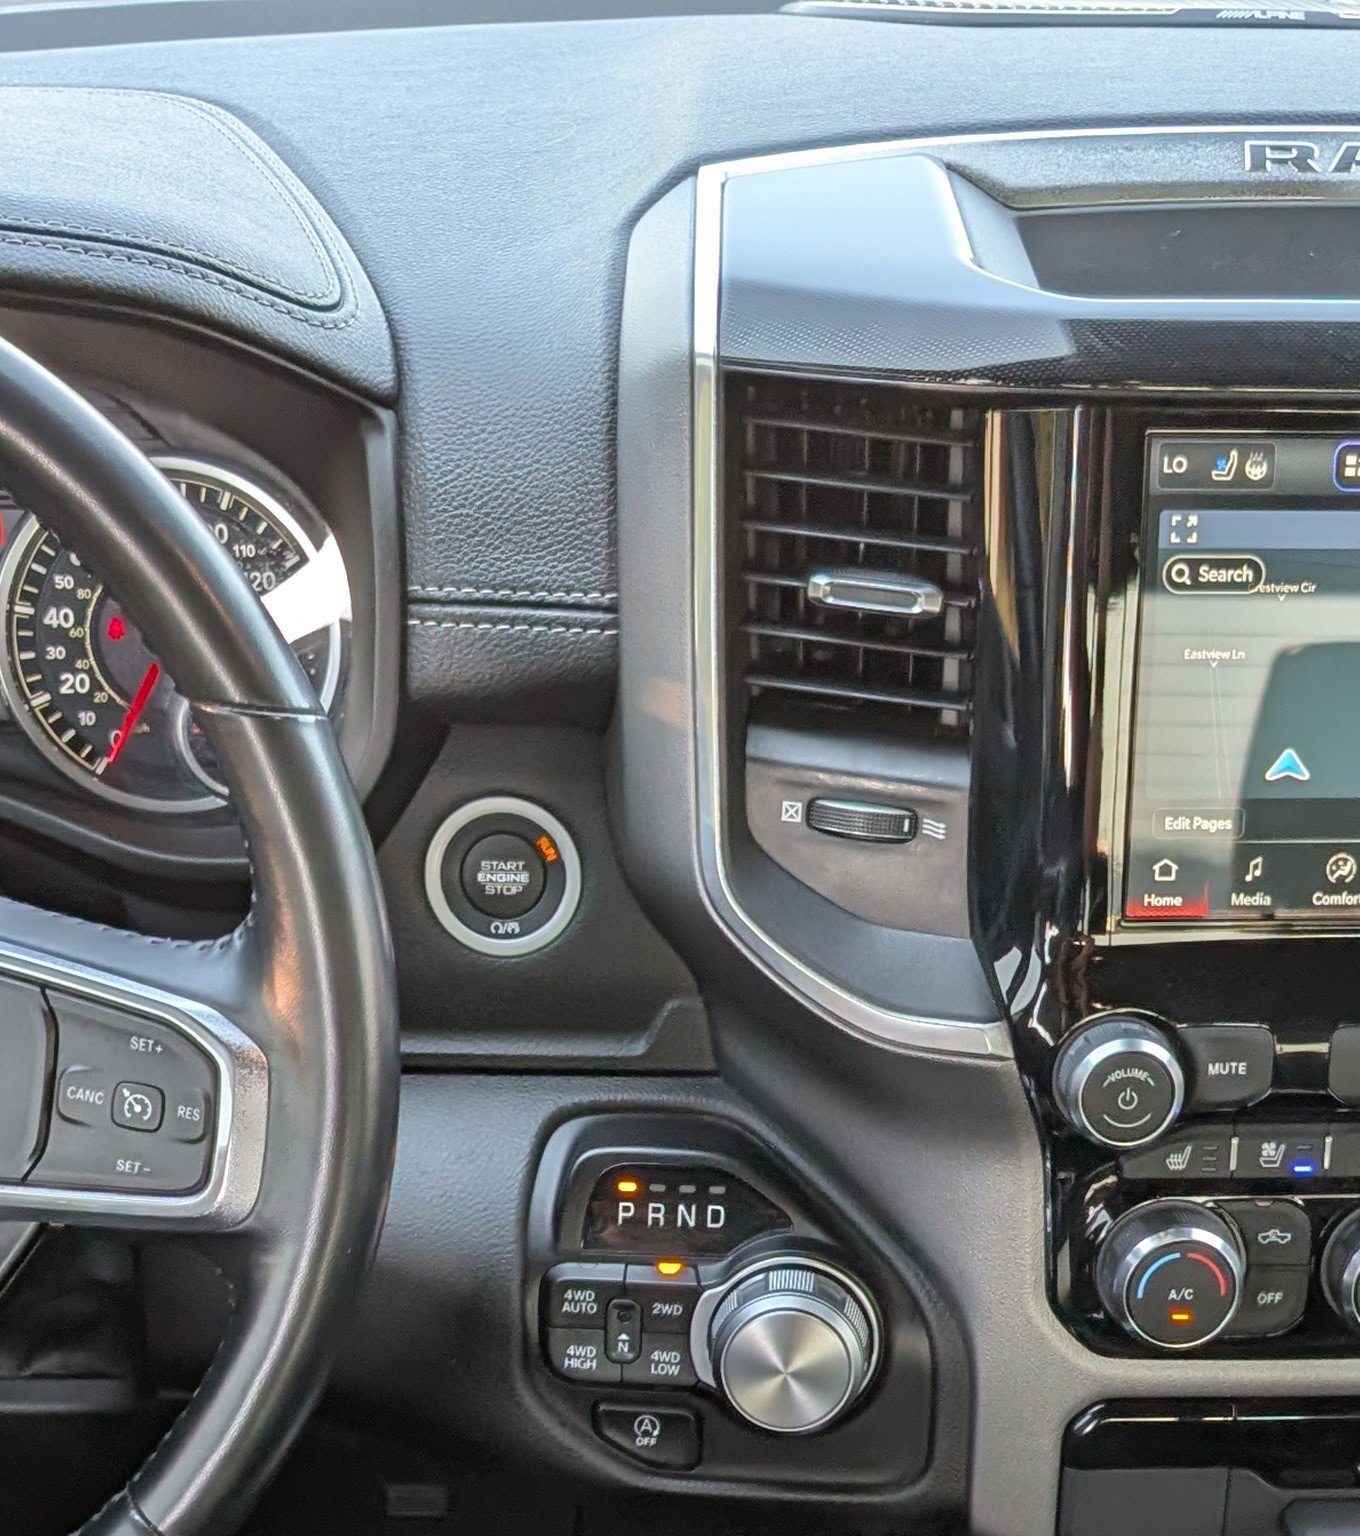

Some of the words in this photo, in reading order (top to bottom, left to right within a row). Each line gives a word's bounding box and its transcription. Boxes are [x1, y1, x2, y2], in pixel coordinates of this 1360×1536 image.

[1163, 454, 1188, 474] LO
[233, 544, 256, 558] 110
[1198, 565, 1254, 583] Search
[53, 574, 75, 591] 50
[244, 571, 276, 593] 20
[1300, 582, 1317, 594] Cir
[76, 586, 92, 600] 80
[43, 606, 75, 629] 40
[69, 626, 84, 639] 60
[45, 645, 67, 660] 30
[1184, 648, 1230, 661] Eastview
[1232, 648, 1245, 660] Ln
[74, 659, 90, 670] 40
[59, 672, 91, 695] 20
[93, 691, 109, 703] 20
[77, 711, 97, 726] 10
[1165, 817, 1190, 831] Edit
[1192, 817, 1233, 833] Pages
[480, 861, 526, 872] START
[477, 872, 530, 883] ENGINE
[484, 884, 524, 896] STOP
[1143, 893, 1183, 907] Home
[1230, 892, 1272, 906] Media
[1109, 1067, 1149, 1083] VOLUME
[1207, 1062, 1247, 1076] MUTE
[66, 1086, 105, 1106] CANC
[176, 1105, 200, 1122] RES
[618, 1201, 635, 1227] P
[647, 1202, 666, 1227] R
[676, 1203, 696, 1228] N
[706, 1204, 725, 1229] D
[564, 1289, 595, 1301] 4WD
[1168, 1287, 1194, 1301] A/C
[1257, 1292, 1284, 1305] OFF
[561, 1301, 597, 1315] AUTO
[652, 1302, 683, 1316] 2WD
[566, 1345, 597, 1358] 4WD
[618, 1340, 629, 1354] N
[563, 1357, 597, 1371] HIGH
[651, 1350, 681, 1364] 4WD
[651, 1363, 680, 1377] LOW
[635, 1435, 657, 1447] OFF
